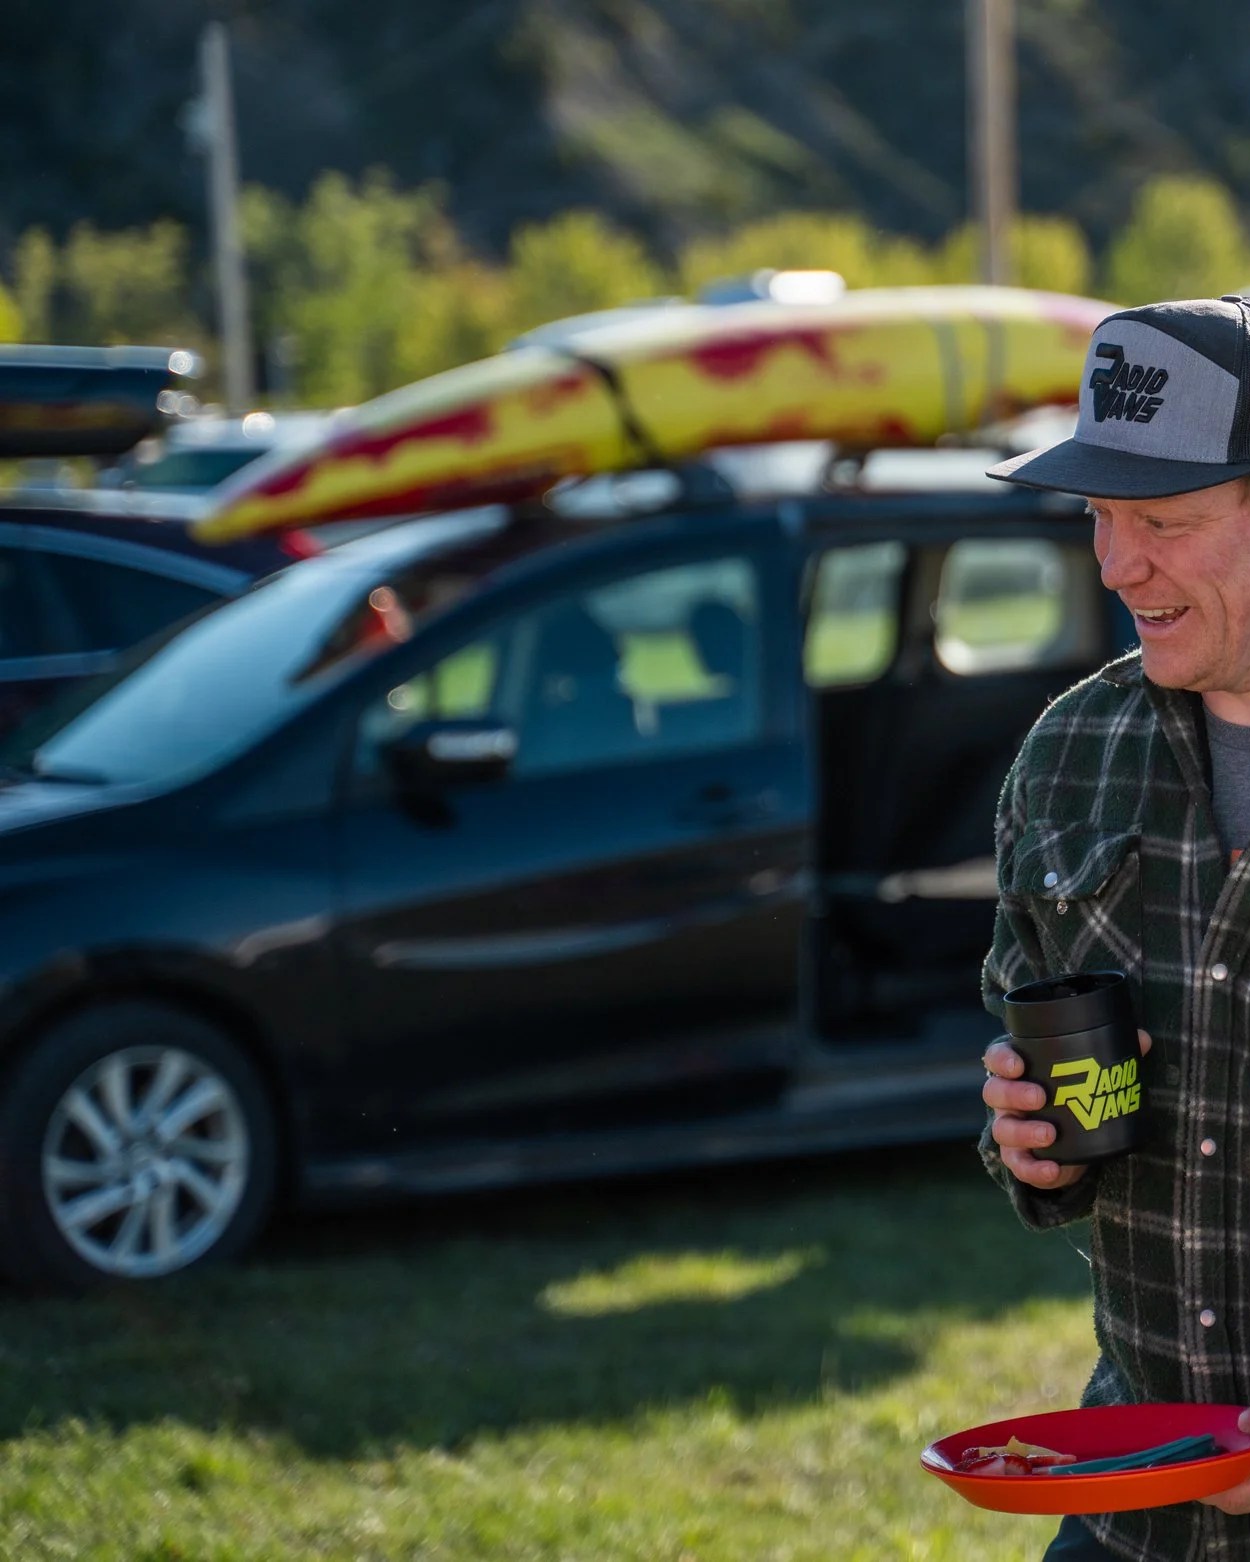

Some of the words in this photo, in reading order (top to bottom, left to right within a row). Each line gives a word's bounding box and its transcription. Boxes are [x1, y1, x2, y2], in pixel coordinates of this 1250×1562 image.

[1089, 343, 1169, 395] RADIO
[1093, 383, 1164, 423] VANS
[1051, 1058, 1137, 1109] RADIO
[1066, 1083, 1141, 1130] VANS
